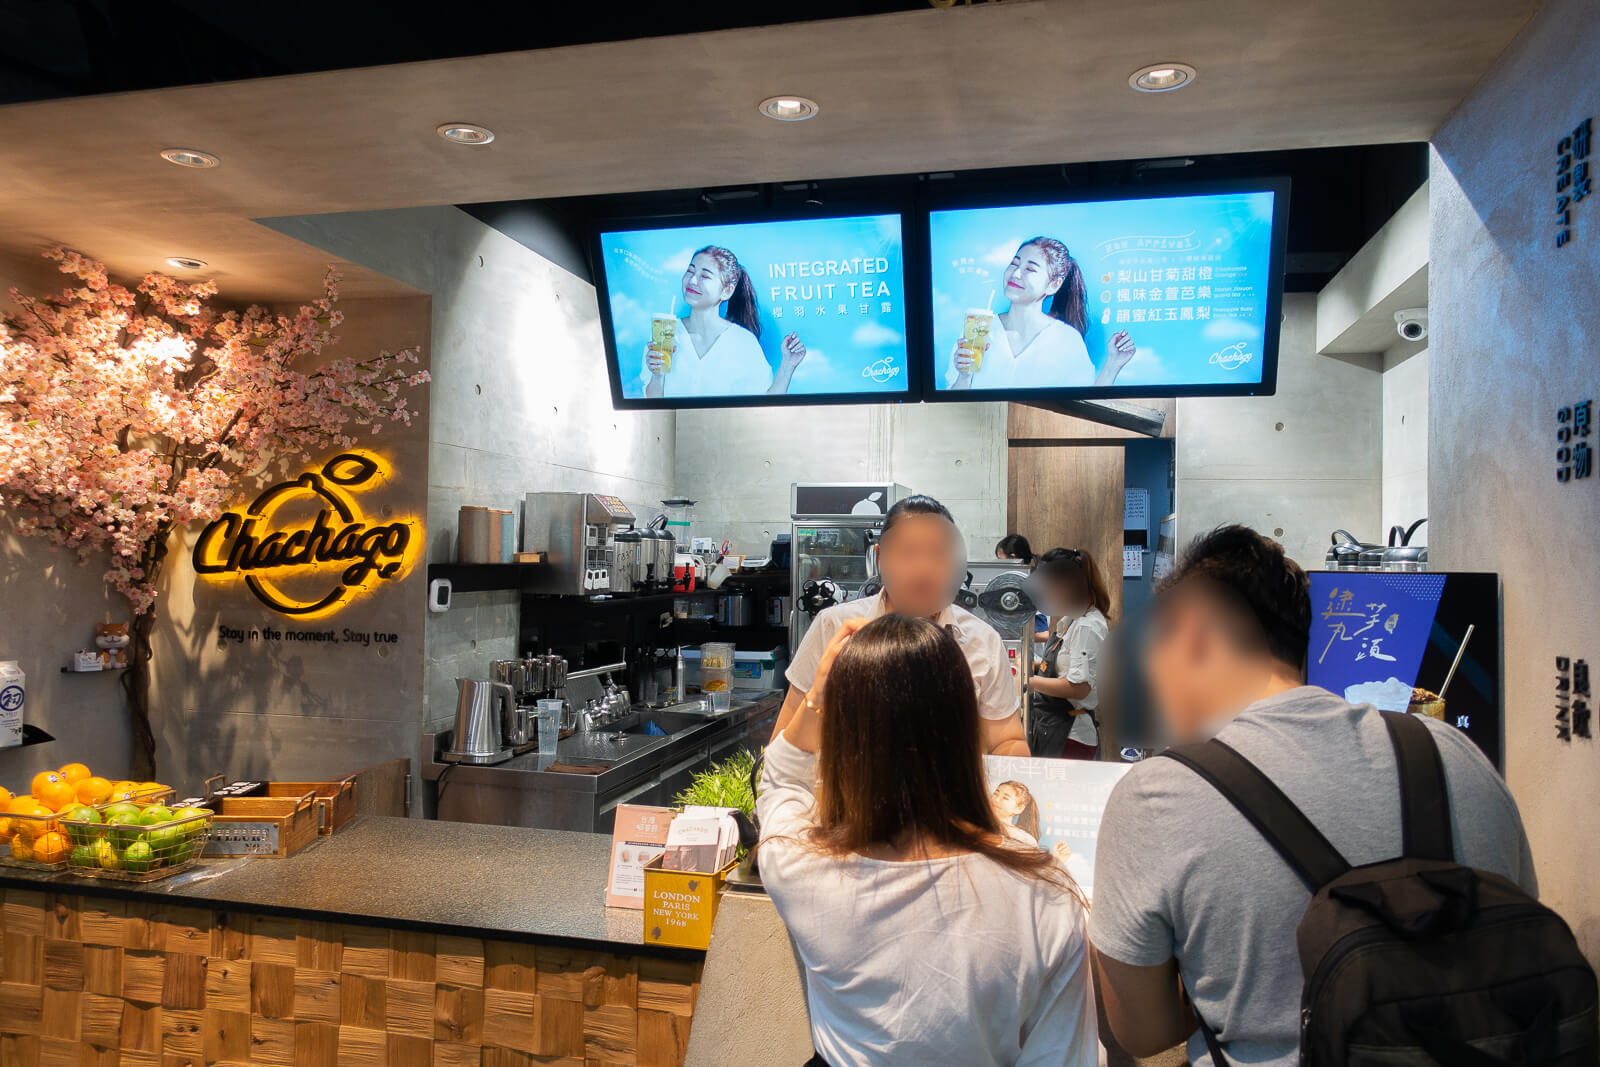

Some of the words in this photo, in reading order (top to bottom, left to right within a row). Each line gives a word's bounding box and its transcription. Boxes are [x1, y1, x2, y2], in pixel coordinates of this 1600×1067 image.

[1556, 136, 1571, 248] CREATE
[769, 257, 889, 278] INTEGRATED
[771, 283, 836, 301] FRUIT
[847, 281, 891, 298] TEA
[1557, 407, 1571, 483] GOOD
[1573, 400, 1592, 480] 原物
[192, 509, 411, 586] Chachago
[218, 625, 244, 643] Stay
[248, 629, 258, 640] in
[262, 627, 281, 640] the
[285, 629, 339, 643] moment,
[343, 629, 371, 646] Stay
[374, 631, 398, 643] true
[1555, 656, 1571, 742] DRINK
[653, 890, 701, 903] LONDON
[663, 900, 690, 911] PARIS
[653, 908, 672, 917] NEW
[676, 910, 699, 920] YORK
